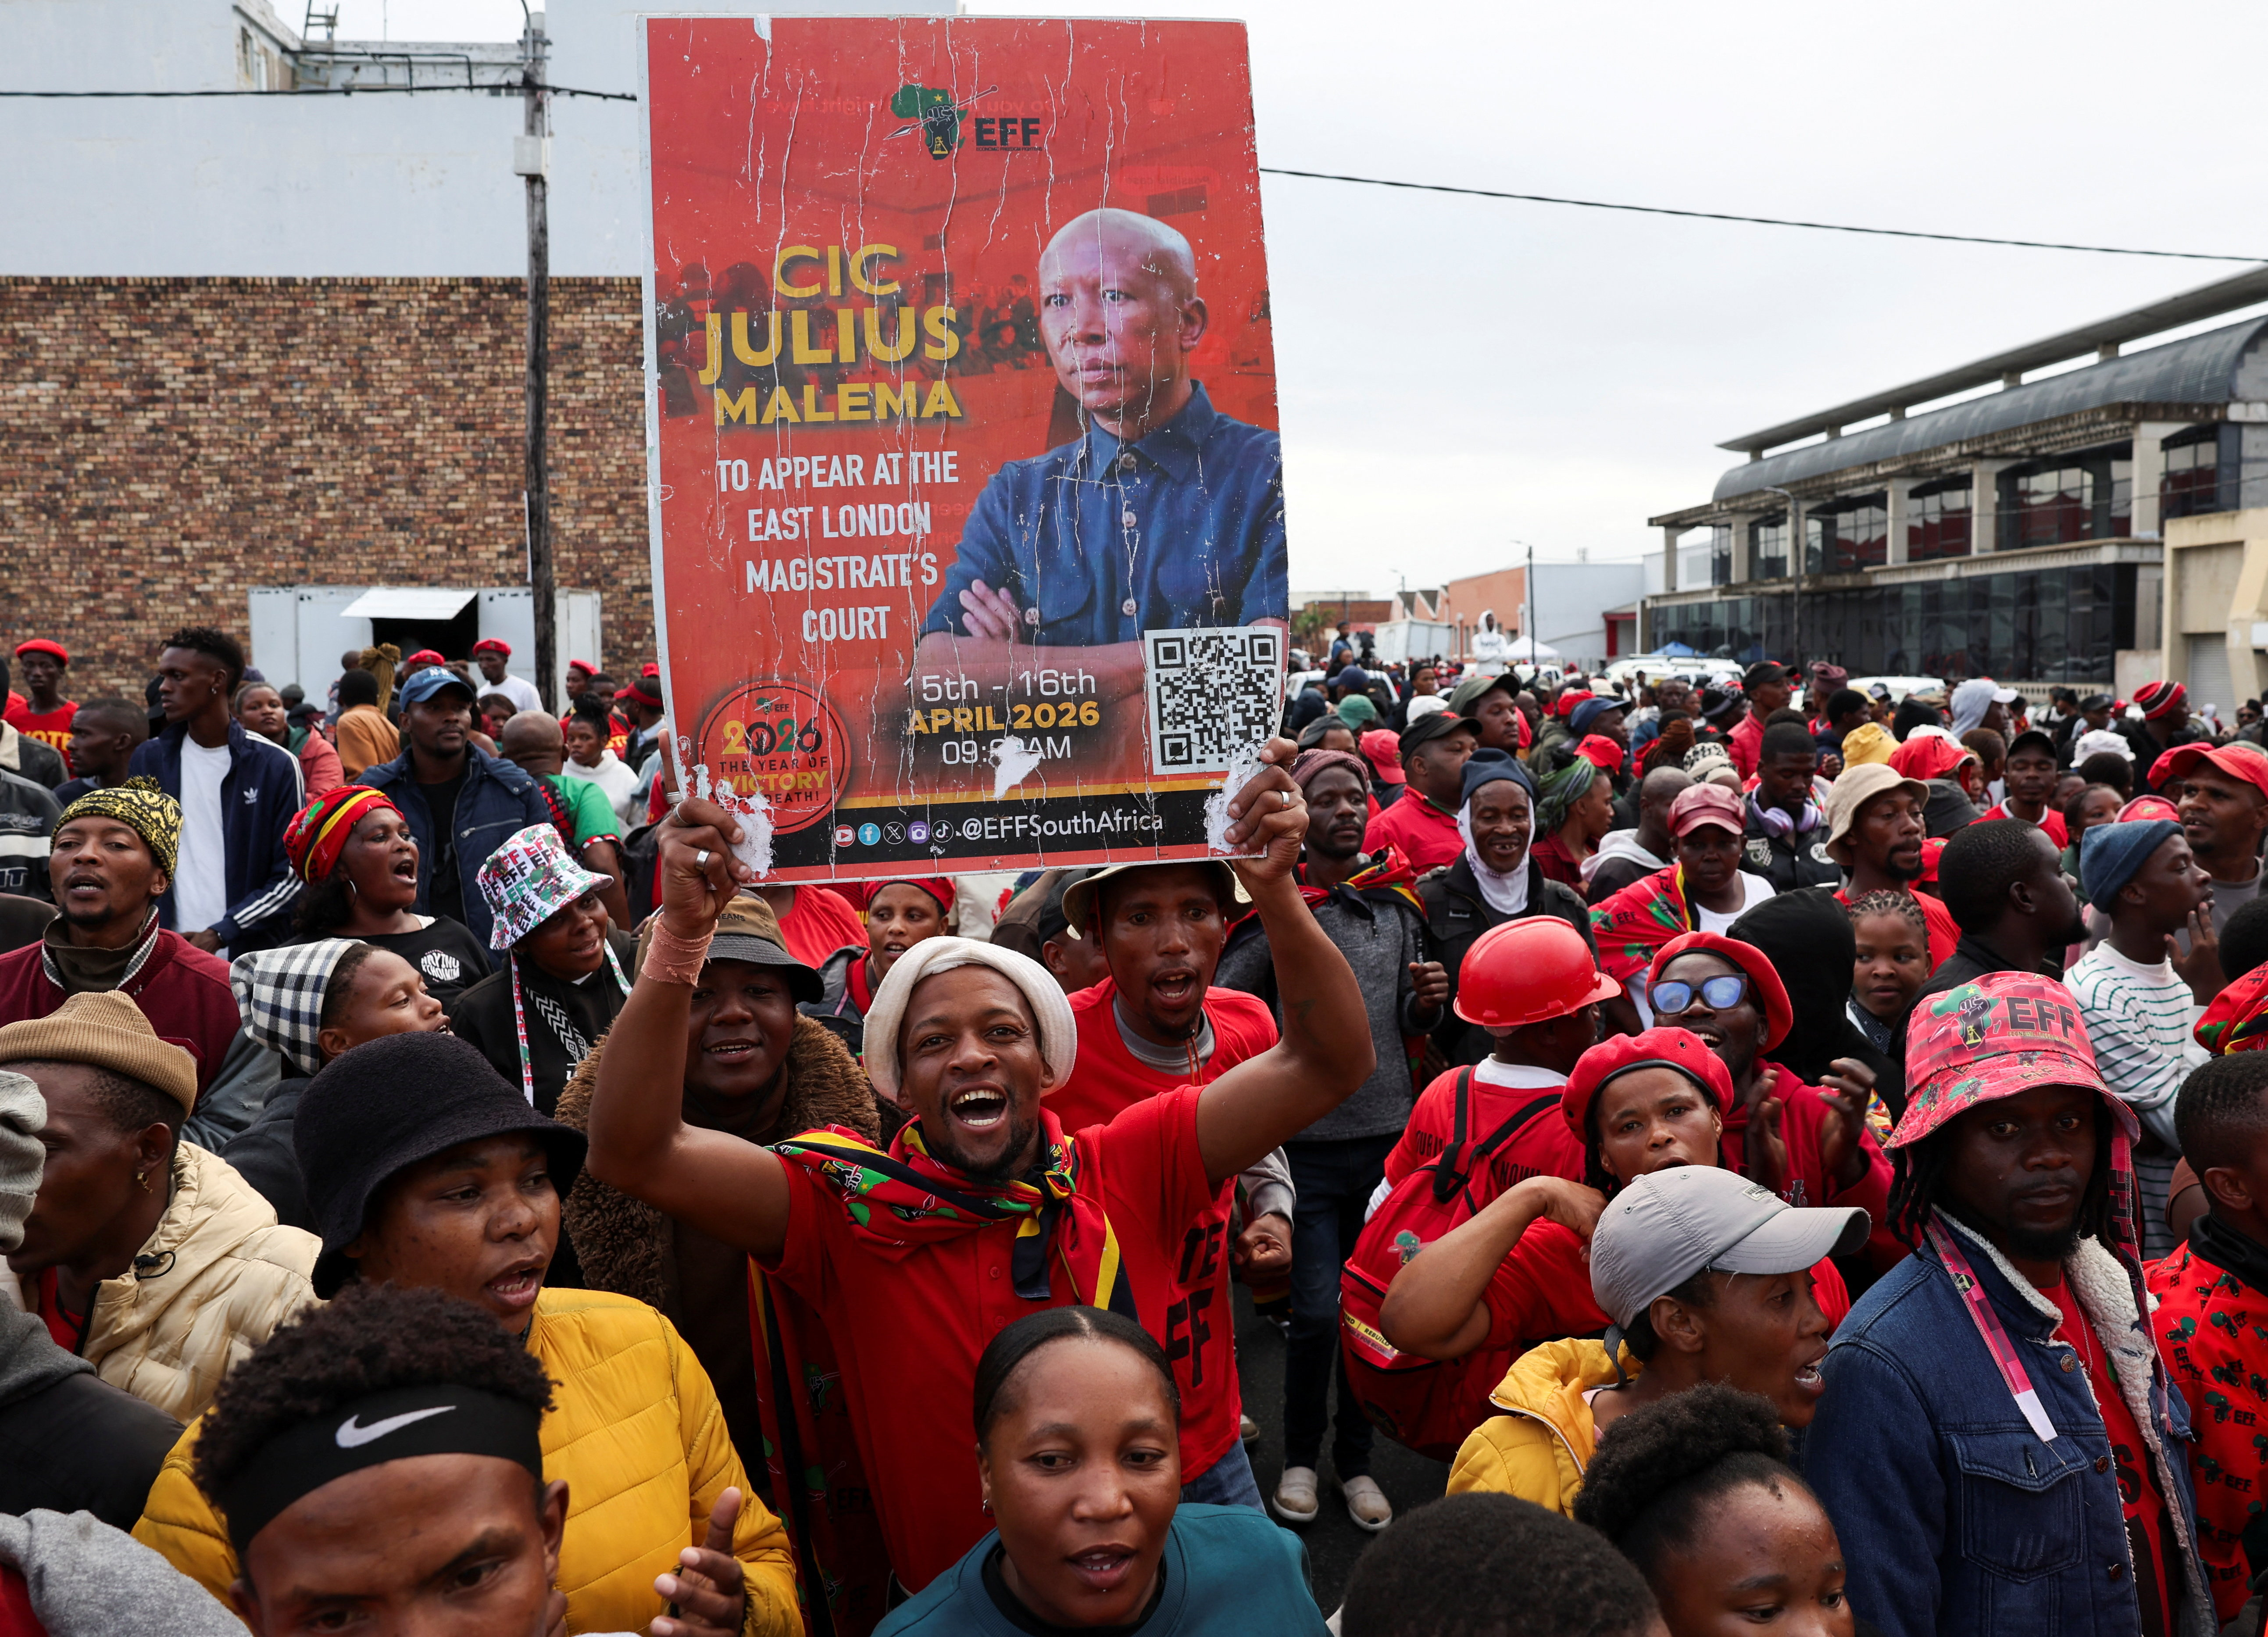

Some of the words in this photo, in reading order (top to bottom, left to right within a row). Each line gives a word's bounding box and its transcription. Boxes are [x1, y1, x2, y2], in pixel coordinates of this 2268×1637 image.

[975, 118, 1040, 146] EFF
[772, 243, 900, 298] CIC
[698, 306, 961, 385] JULIUS
[716, 380, 962, 425] MALEMA
[718, 459, 748, 492] TO
[758, 454, 865, 490] APPEAR
[873, 453, 903, 485] AT
[910, 451, 959, 483] THE
[748, 507, 813, 541] EAST
[822, 502, 931, 538] LONDON
[746, 553, 938, 593] MAGISTRATE'S
[803, 606, 891, 643] COURT
[1019, 668, 1096, 696] 16th
[907, 706, 1004, 735] APRIL
[1012, 701, 1100, 729] 2026
[721, 717, 822, 756] 2026
[720, 761, 753, 772] THE
[759, 760, 800, 772] YEAR
[809, 756, 828, 768] OF
[723, 771, 828, 792] VICTORY
[962, 808, 1164, 840] @EFFSouthAfrica
[1616, 911, 1636, 923] EFF
[2006, 997, 2075, 1039] EFF
[1364, 1328, 1389, 1346] REBUILD
[2234, 1409, 2256, 1426] EFF
[2225, 1474, 2252, 1492] EFF
